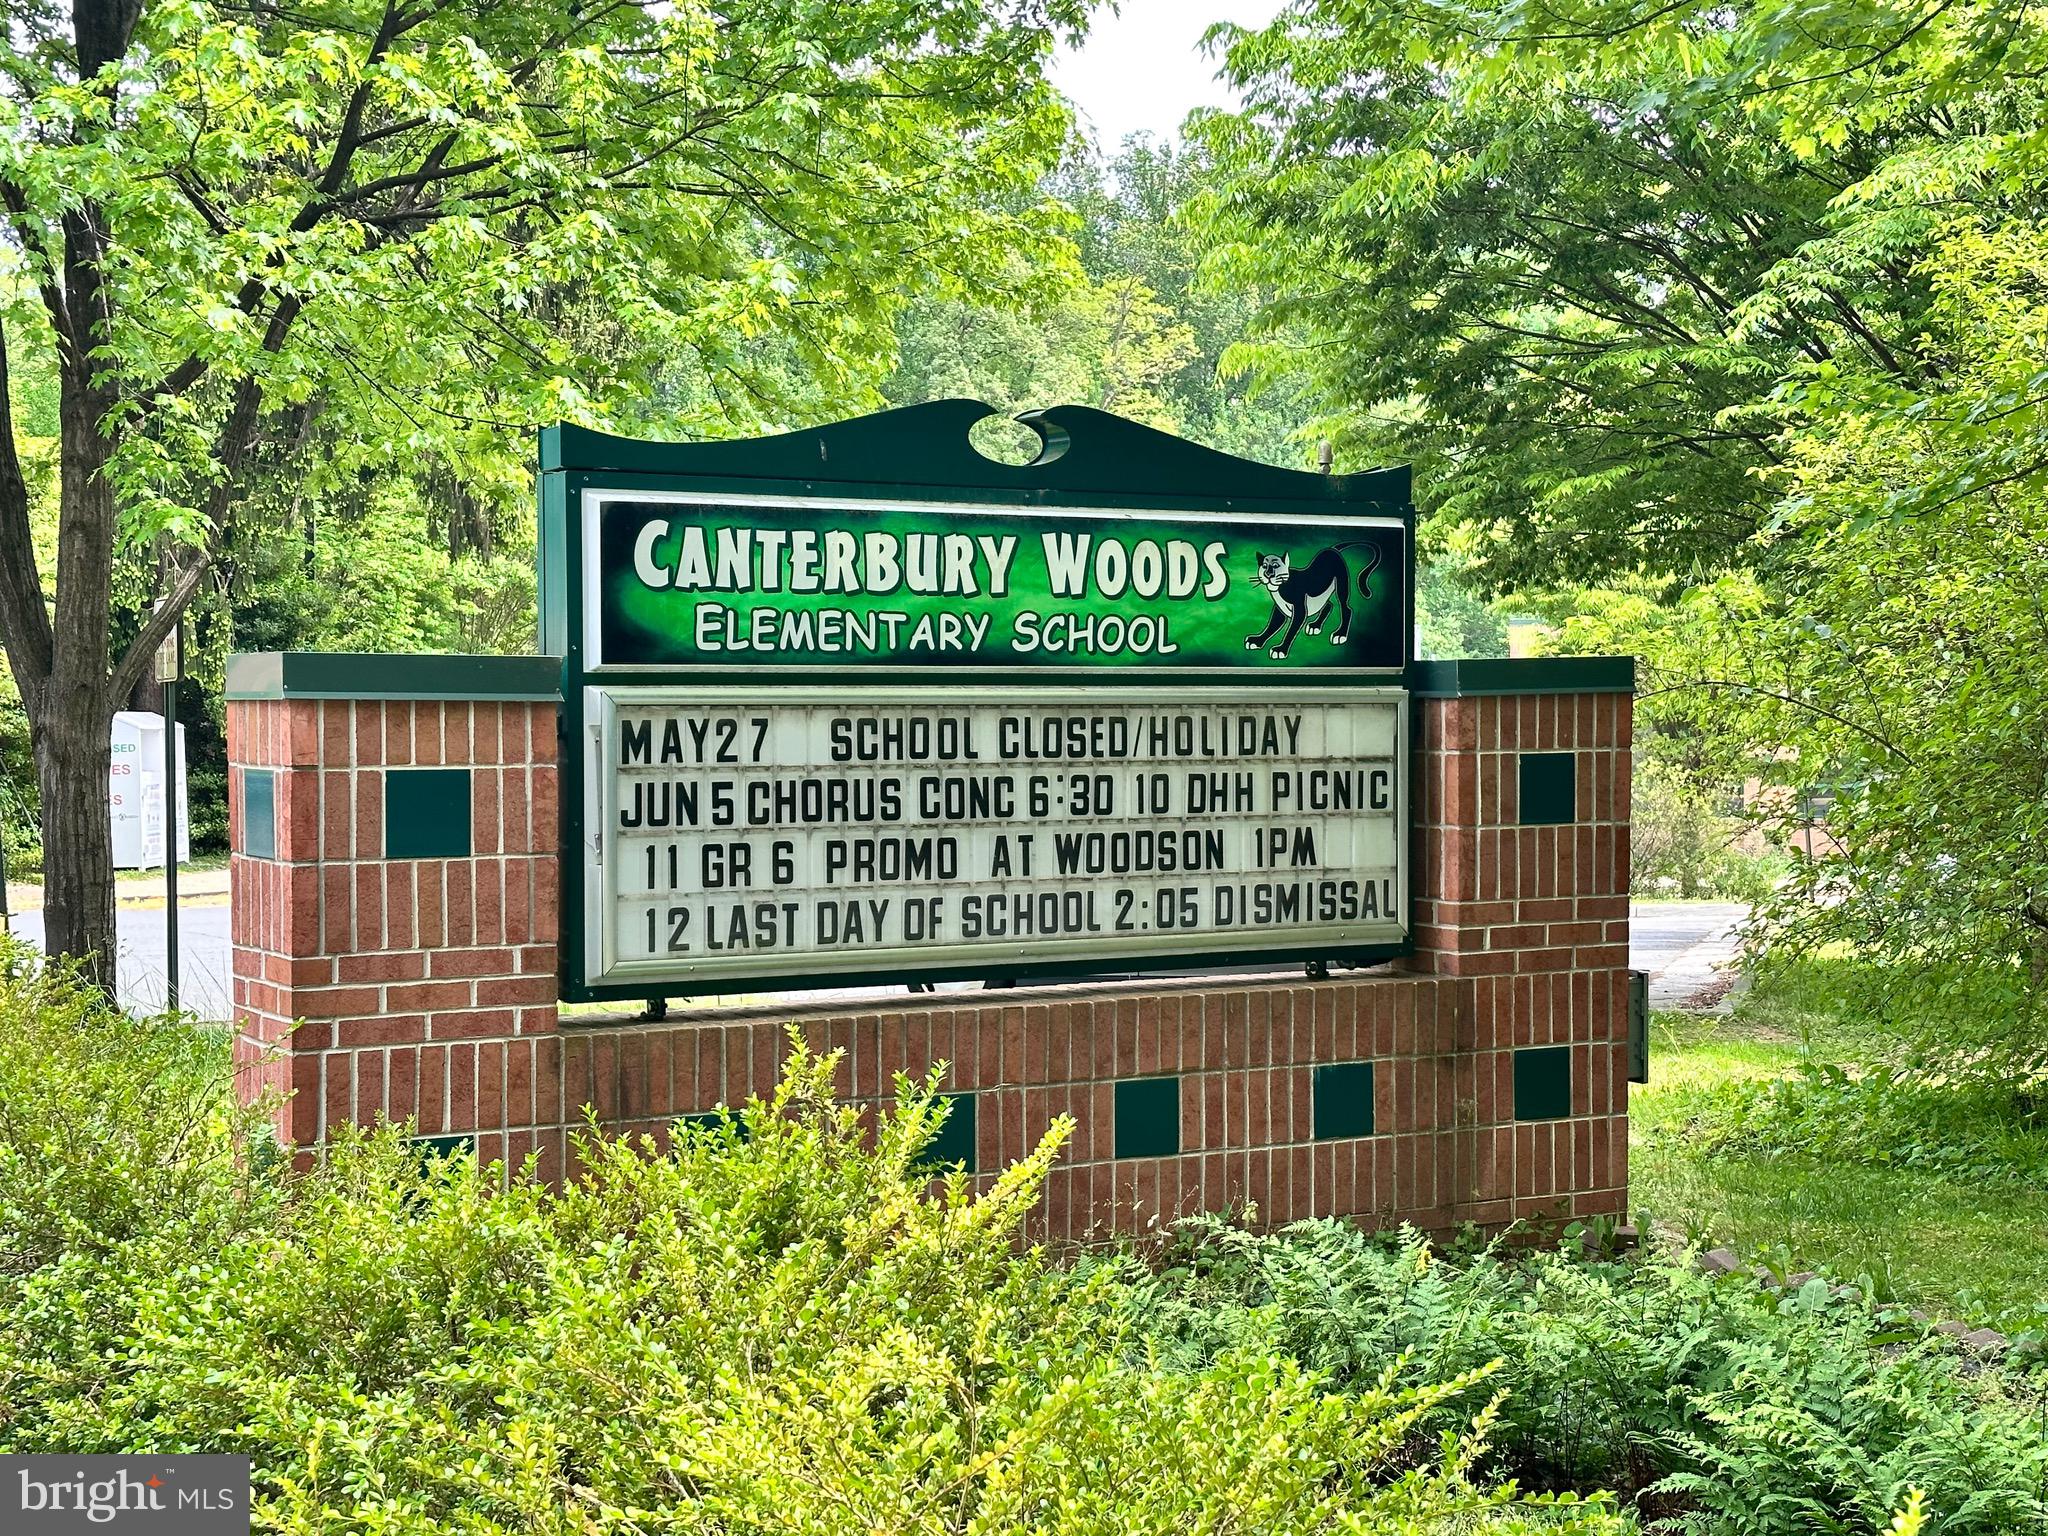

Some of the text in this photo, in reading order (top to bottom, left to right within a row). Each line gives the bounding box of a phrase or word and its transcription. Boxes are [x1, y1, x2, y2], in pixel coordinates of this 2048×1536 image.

[632, 518, 1230, 600] CANTERBURY WOODS
[695, 603, 1178, 654] ELEMENTARY SCHOOL
[830, 716, 978, 761] SCHOOL
[1000, 714, 1302, 759] CLOSED/HOLIDAY
[620, 769, 1389, 828] JUN 5 CHORUS CONC 6:30 10 DHH PICNIC
[646, 827, 1317, 889] 11 GR 6 PROMO AT WOODSON 1PM
[646, 878, 1396, 953] 12 LAST DAY OF SCHOOL 2:05 DISMISSAL
